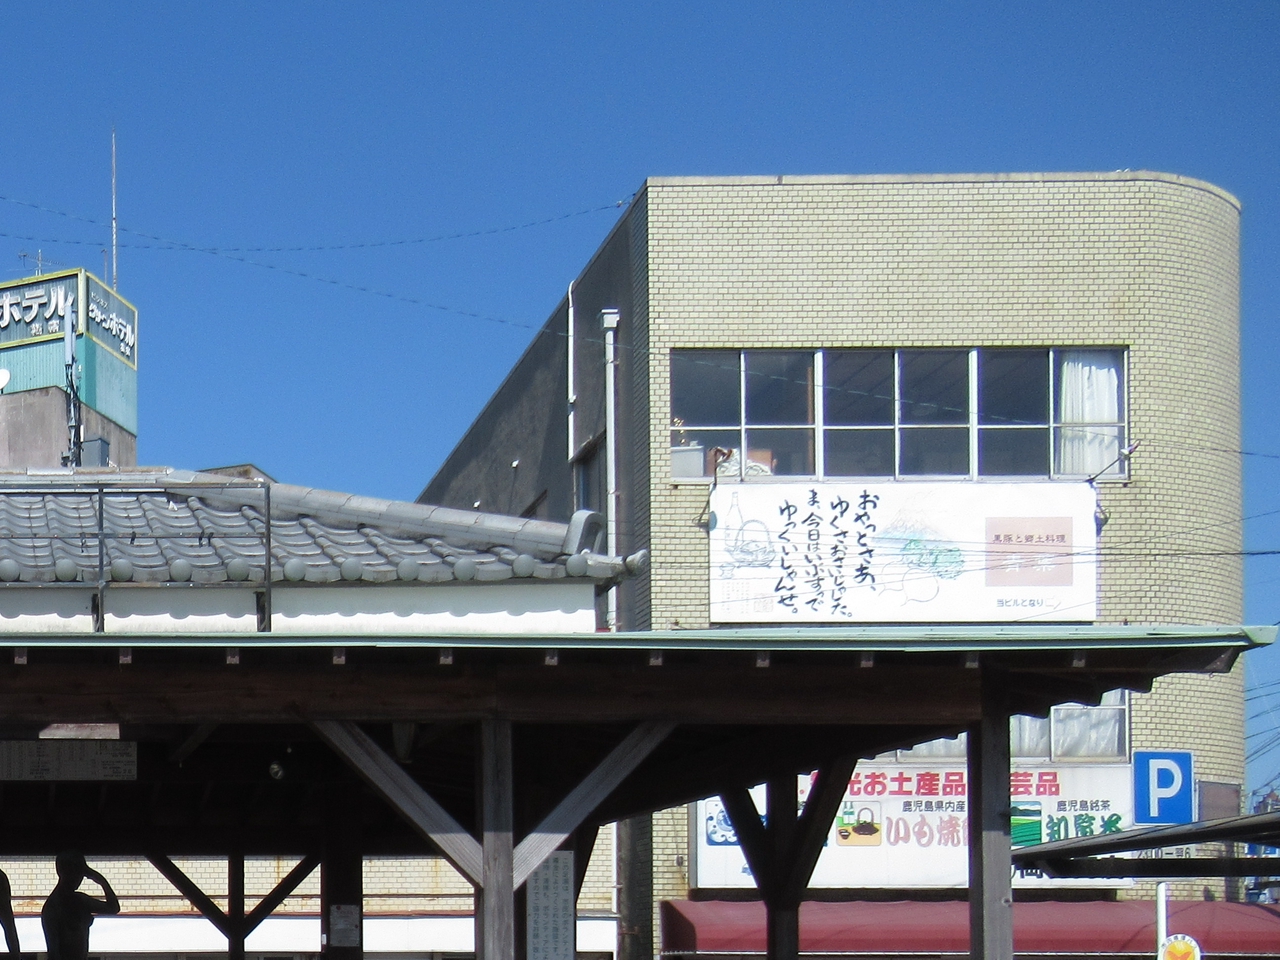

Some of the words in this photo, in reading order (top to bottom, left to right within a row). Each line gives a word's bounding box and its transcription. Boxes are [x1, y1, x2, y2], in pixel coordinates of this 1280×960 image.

[993, 534, 1067, 543] 黒豚と郷土料理
[997, 599, 1043, 607] 当ビルとなり
[1148, 758, 1183, 817] P
[1057, 800, 1111, 812] 鹿児島銘茶
